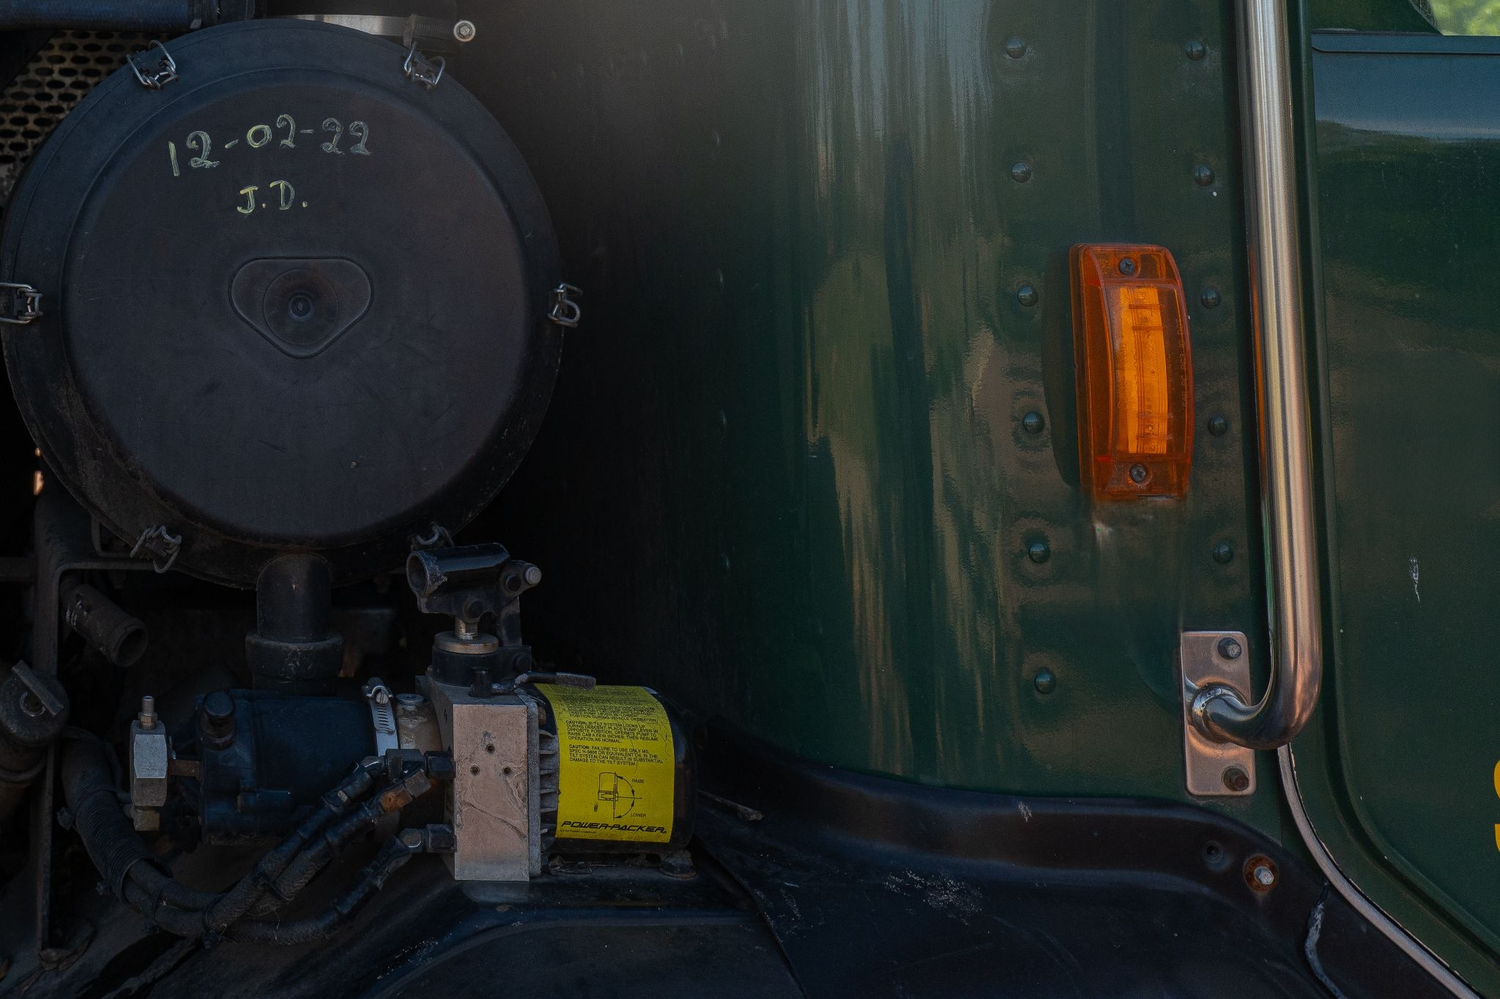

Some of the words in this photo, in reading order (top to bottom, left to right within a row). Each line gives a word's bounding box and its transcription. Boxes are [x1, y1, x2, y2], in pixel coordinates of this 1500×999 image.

[168, 113, 371, 176] 12-02-22
[237, 180, 308, 214] J.D.
[562, 821, 664, 833] POWER-PACKER
